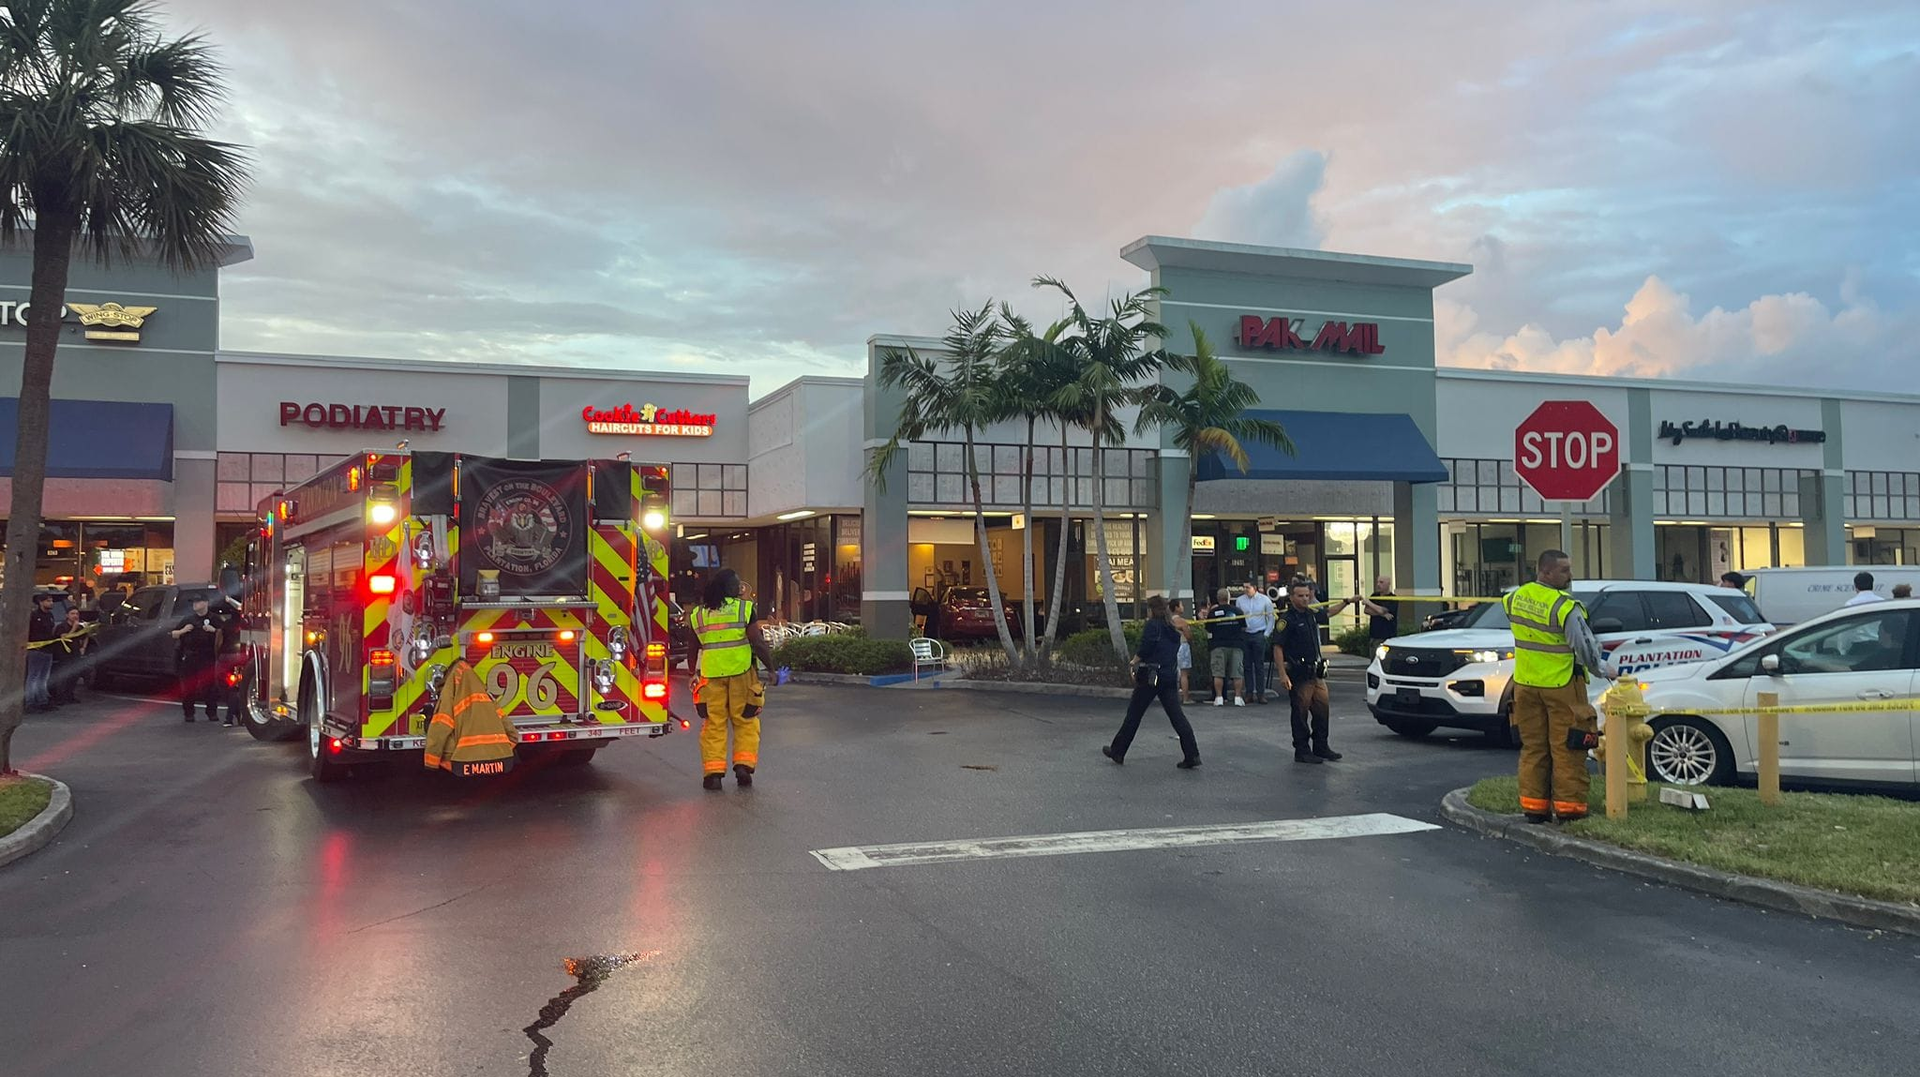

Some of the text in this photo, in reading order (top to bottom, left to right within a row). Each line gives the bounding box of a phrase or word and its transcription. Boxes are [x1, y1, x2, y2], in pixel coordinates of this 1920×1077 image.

[1239, 315, 1386, 354] PAK MAIL
[280, 402, 447, 432] PODIATRY
[582, 402, 640, 423] Cookie
[591, 422, 710, 436] HAIRCUTS FOR KIDS
[1521, 431, 1613, 469] STOP
[477, 486, 505, 519] BRAVEST
[515, 482, 530, 490] THE
[530, 483, 567, 523] BOULEVARD
[1193, 538, 1212, 546] FedEx
[534, 547, 563, 571] FLORIDA
[1807, 584, 1831, 593] CRIME
[1834, 584, 1857, 593] SCEN
[490, 644, 555, 659] ENGINE
[1619, 649, 1703, 665] PLANTATION
[486, 662, 558, 711] 96
[587, 727, 640, 737] 343 FEET
[463, 761, 504, 776] E MARTIN
